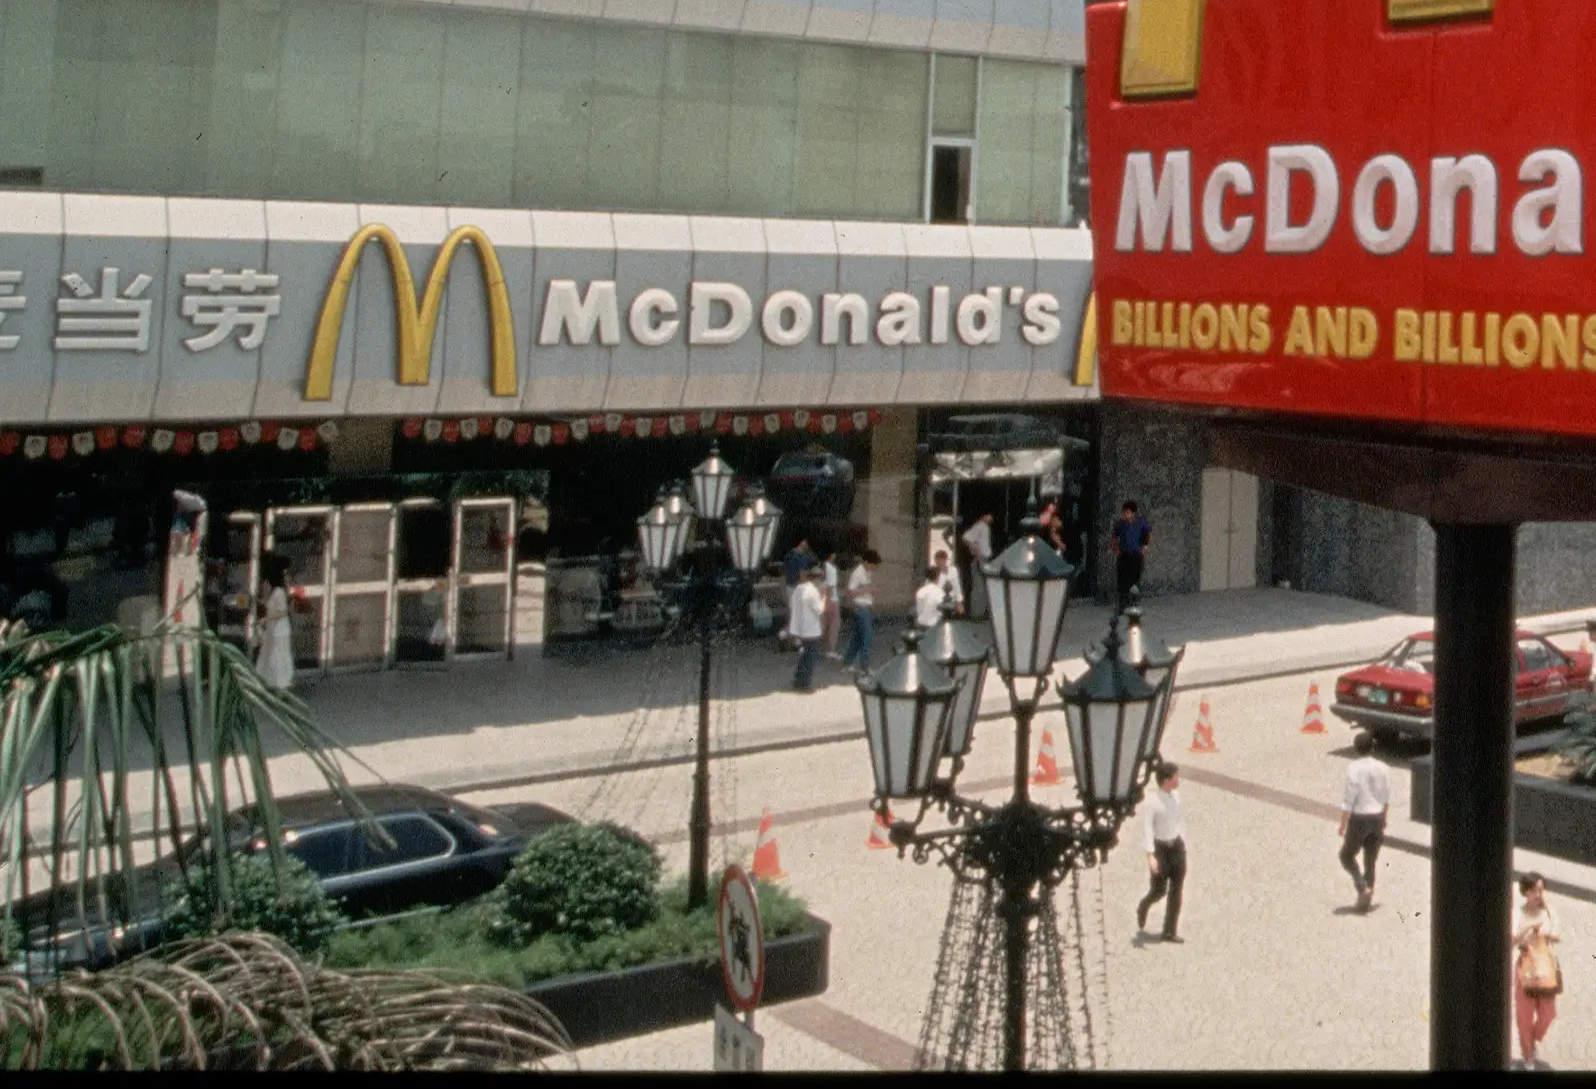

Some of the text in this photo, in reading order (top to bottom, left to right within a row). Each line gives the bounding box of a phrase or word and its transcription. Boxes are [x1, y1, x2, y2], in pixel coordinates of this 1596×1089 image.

[0, 266, 281, 353] 当劳
[538, 279, 1062, 347] McDonald's
[1111, 300, 1272, 354] BILLIONS
[1284, 305, 1379, 360] AND
